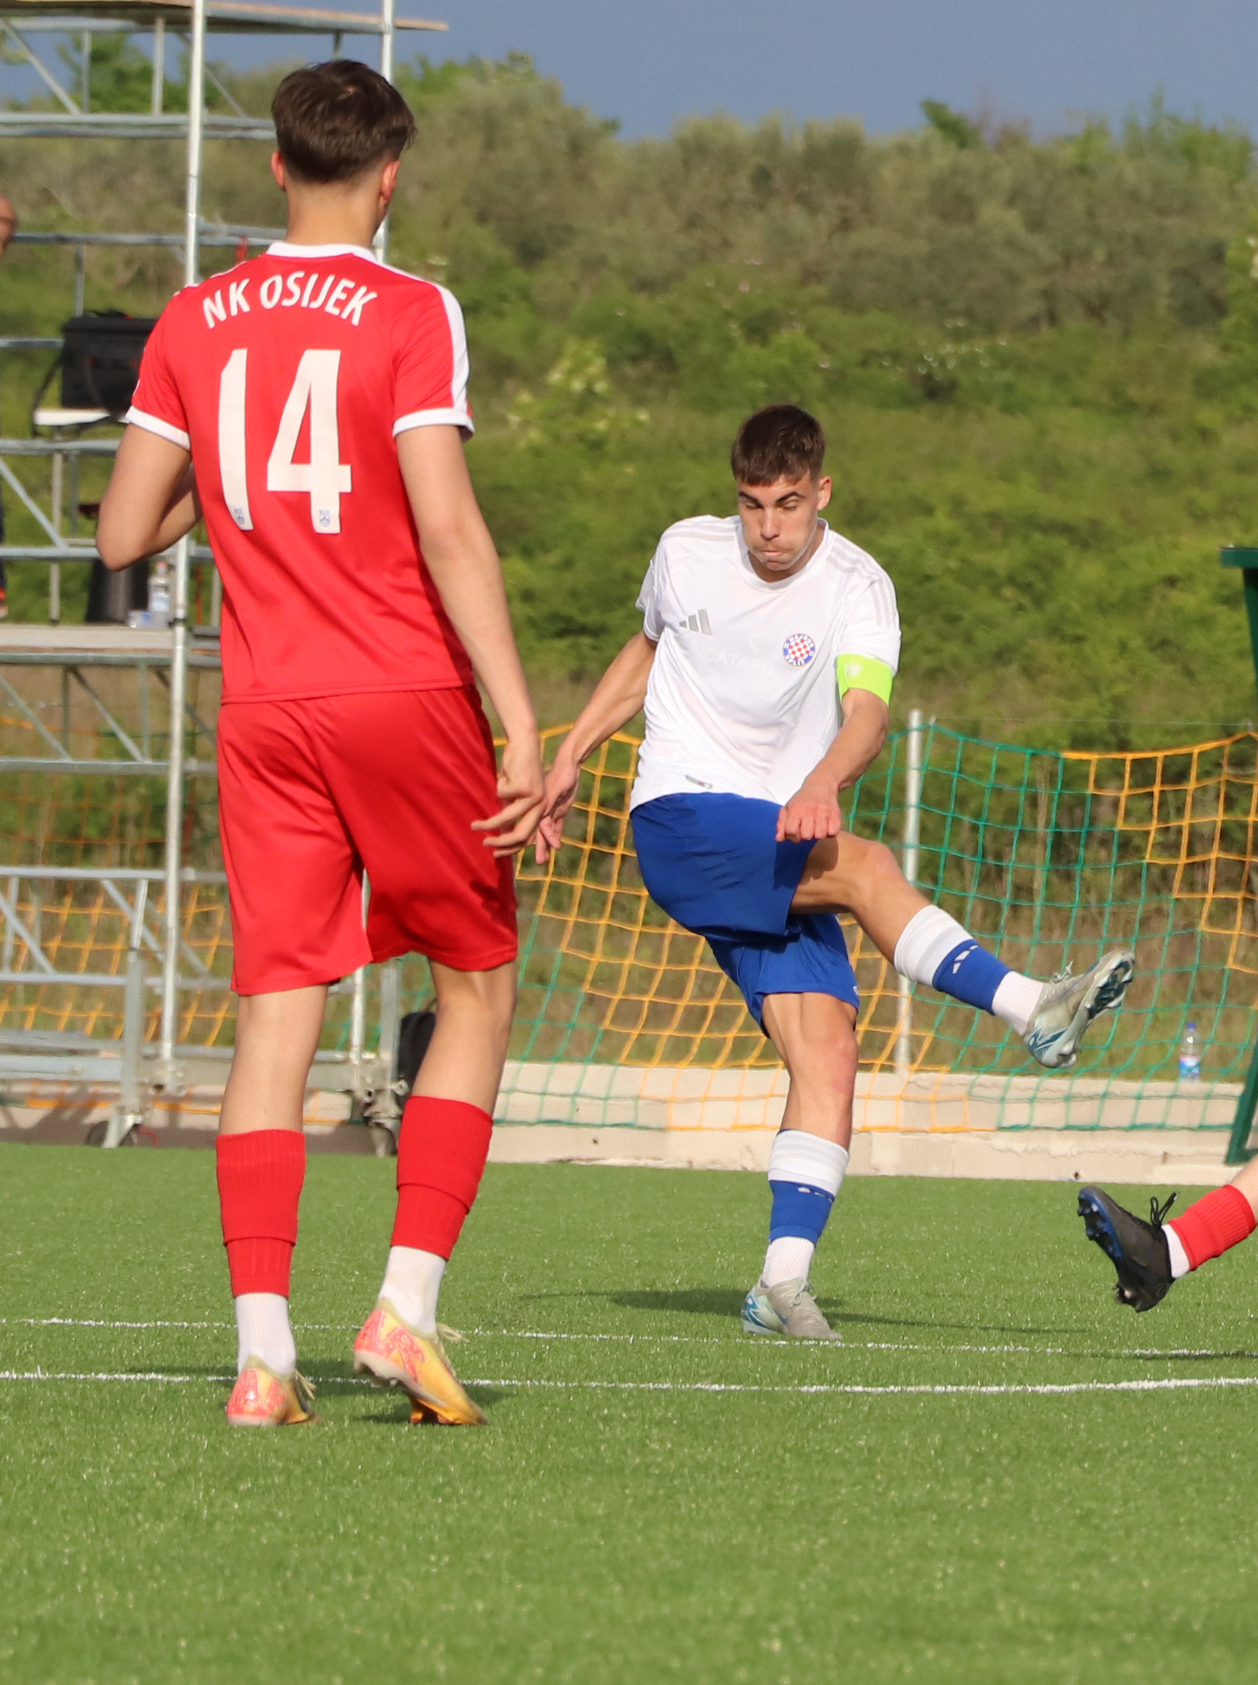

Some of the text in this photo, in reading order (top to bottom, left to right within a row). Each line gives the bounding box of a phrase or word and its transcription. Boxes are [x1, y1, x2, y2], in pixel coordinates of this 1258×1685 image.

[203, 270, 378, 329] NK OSIJEK
[218, 348, 352, 533] 14
